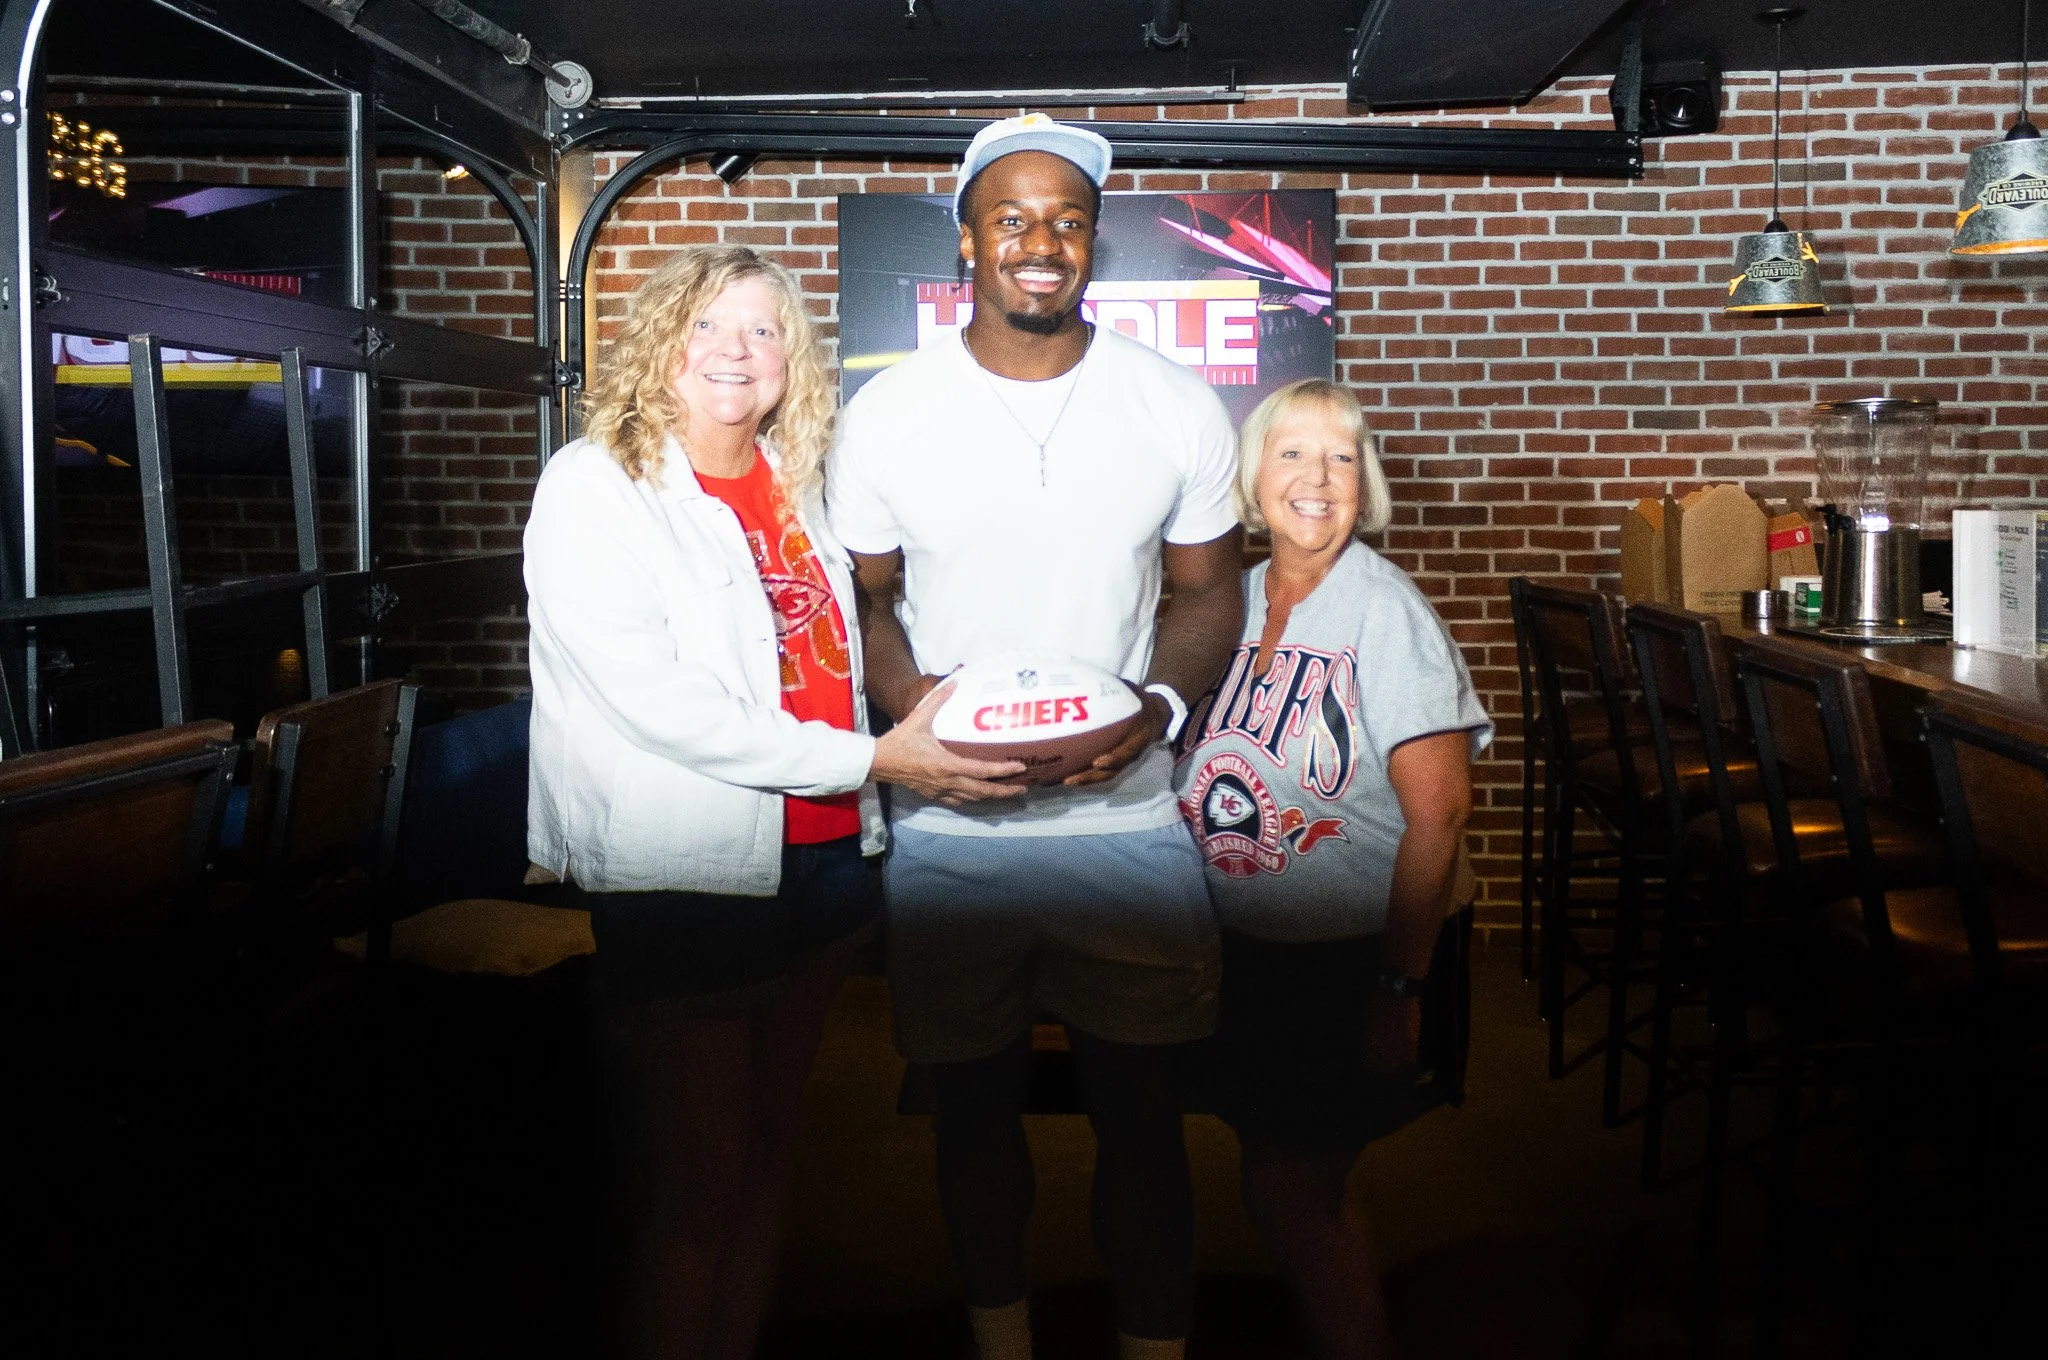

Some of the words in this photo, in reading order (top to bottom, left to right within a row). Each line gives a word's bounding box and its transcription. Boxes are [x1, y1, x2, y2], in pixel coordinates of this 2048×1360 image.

[1988, 187, 2048, 204] OULEVARD
[1752, 263, 1800, 277] BOULEVARD
[917, 301, 1258, 366] HDLE
[973, 696, 1088, 731] CHIEFS
[1172, 643, 1358, 801] HIEFS
[1210, 755, 1258, 790] FOOTBALL
[1220, 793, 1243, 817] KC
